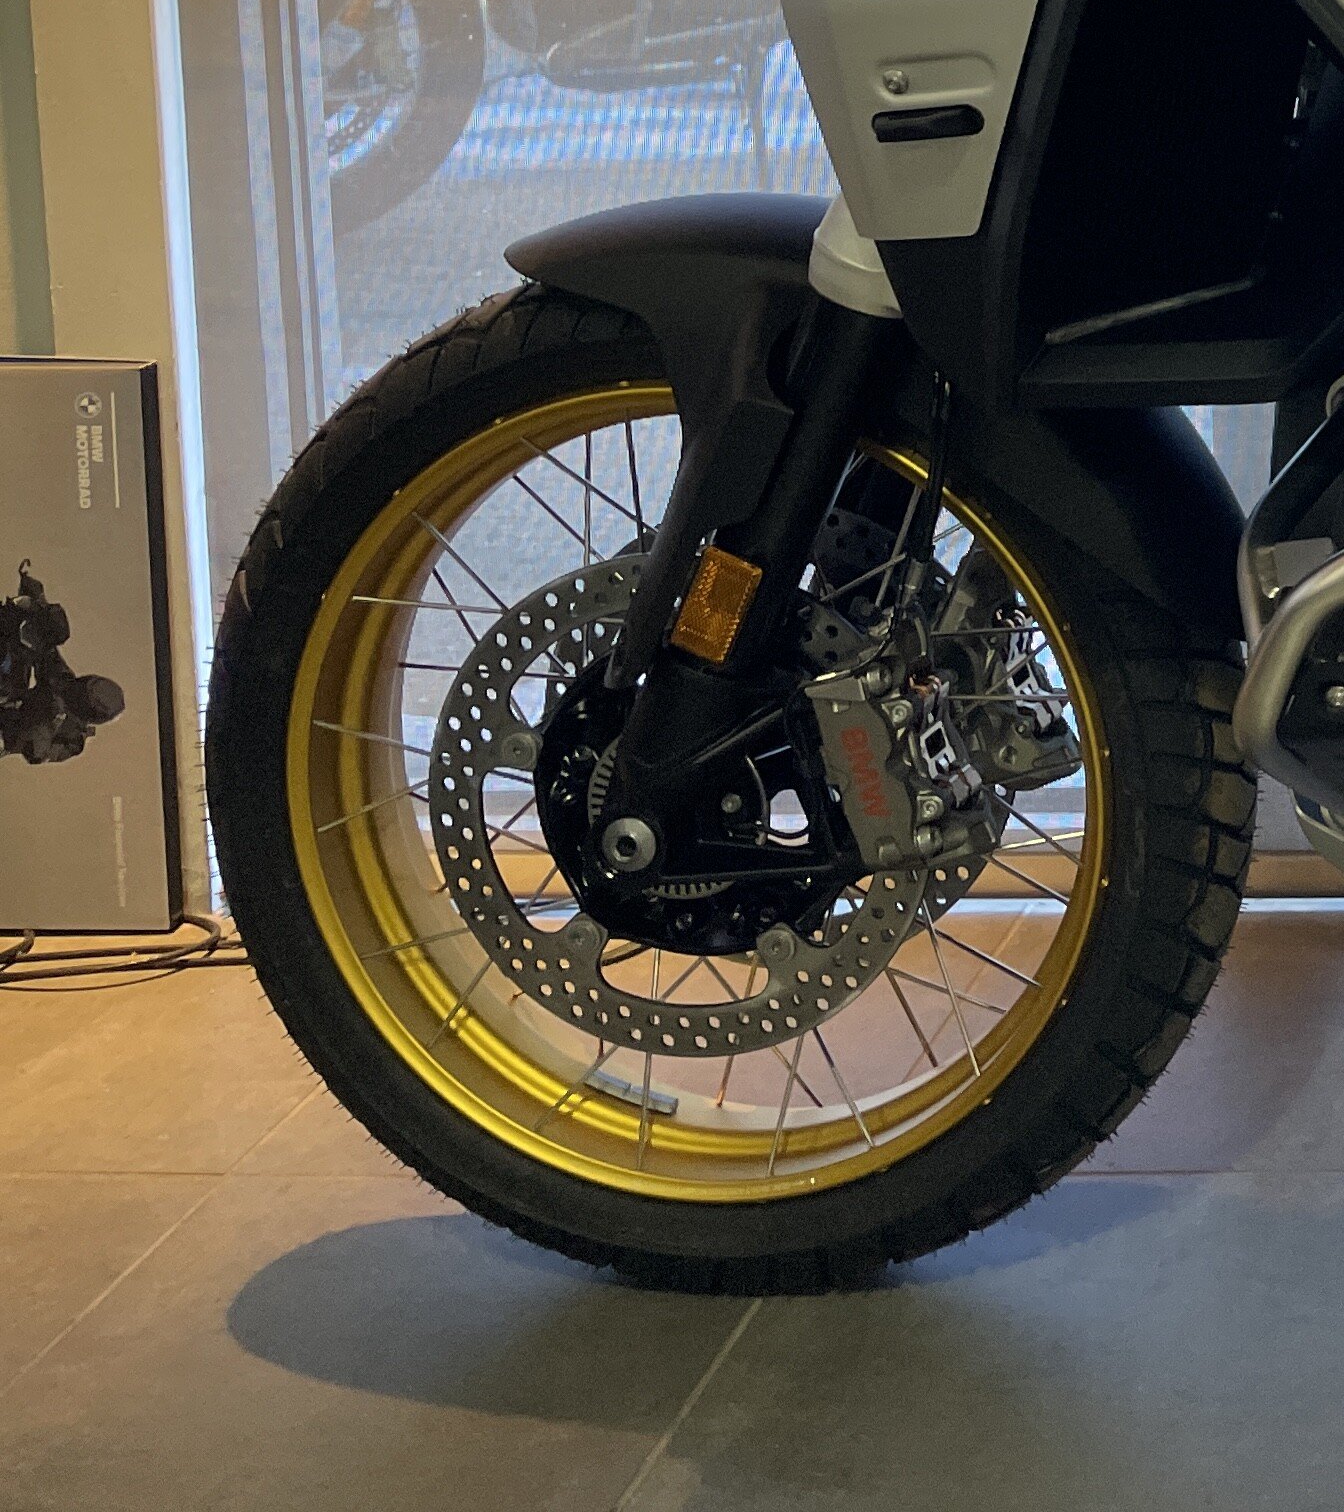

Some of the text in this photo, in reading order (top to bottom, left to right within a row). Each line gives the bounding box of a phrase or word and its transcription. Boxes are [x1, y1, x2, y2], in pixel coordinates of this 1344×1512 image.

[76, 425, 91, 508] MOTORRAD
[91, 425, 103, 462] BMW
[842, 728, 889, 816] BMW
